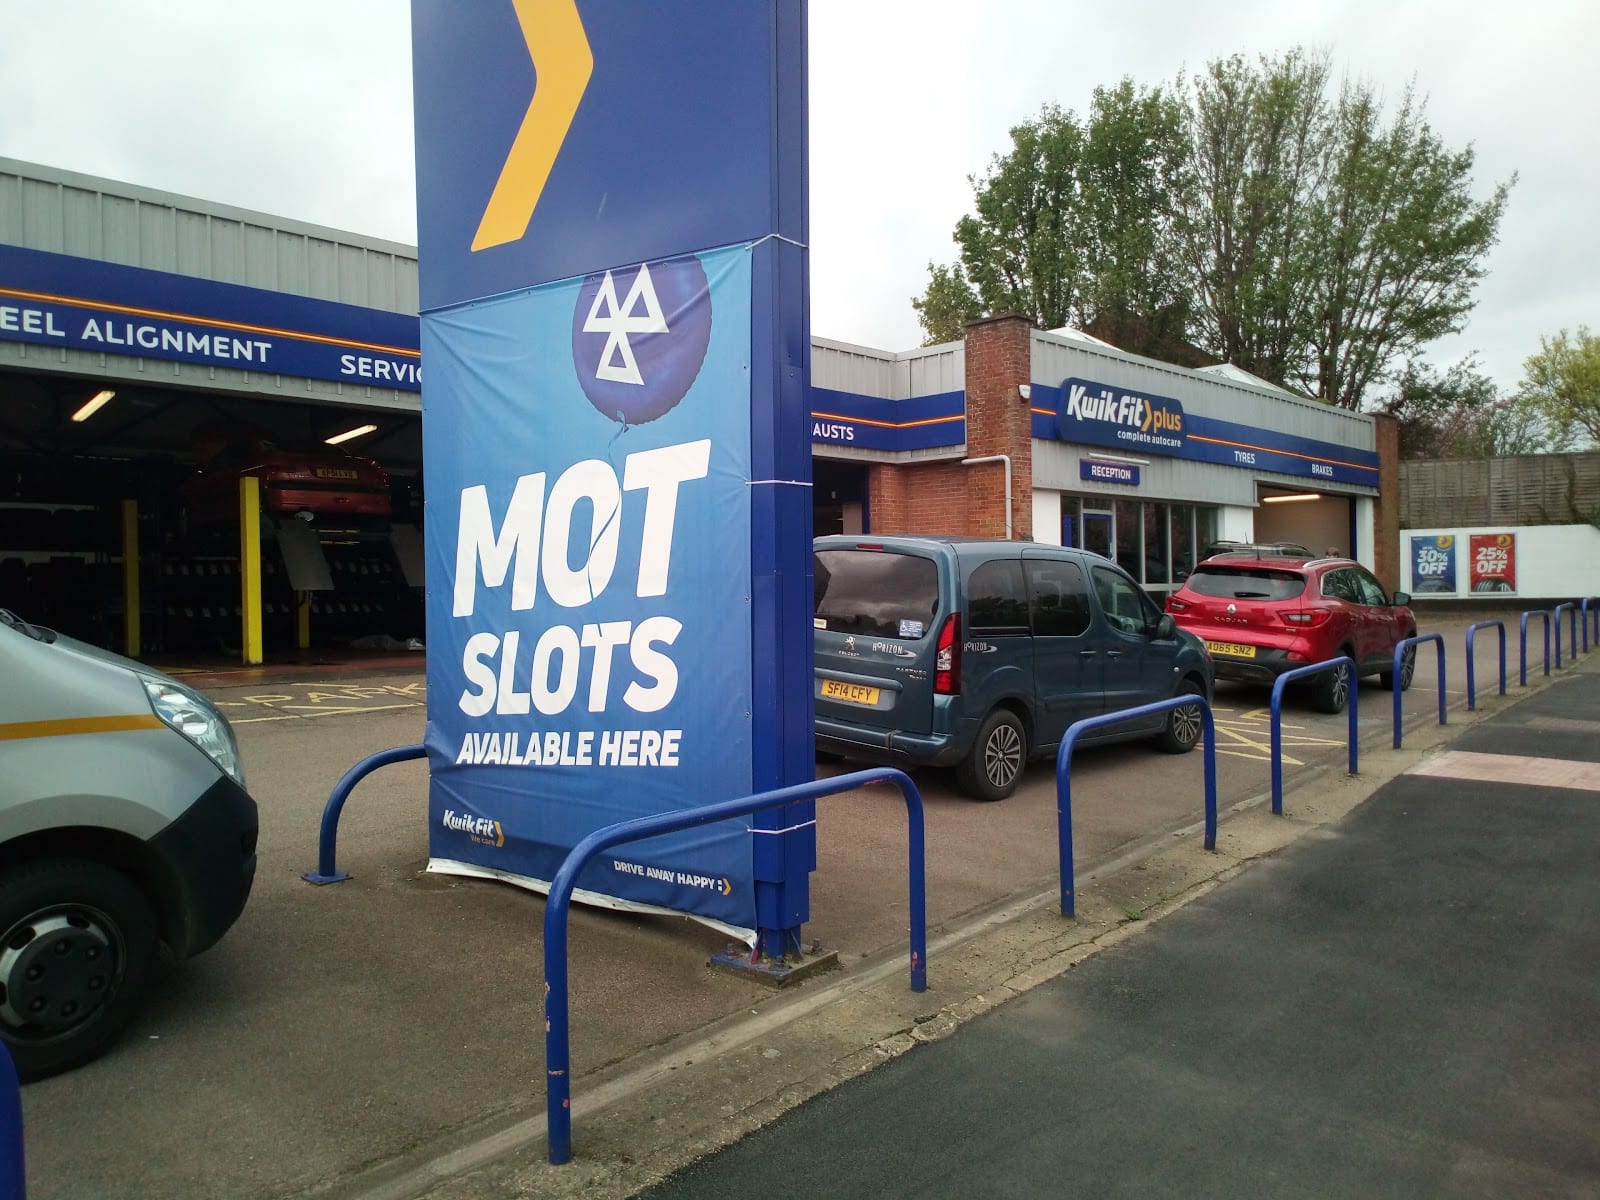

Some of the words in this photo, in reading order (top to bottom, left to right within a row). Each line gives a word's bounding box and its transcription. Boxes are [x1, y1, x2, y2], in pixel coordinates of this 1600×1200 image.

[81, 318, 272, 363] ALIGNMENT
[1153, 407, 1182, 433] plus
[811, 422, 854, 440] AUSTS
[1117, 430, 1151, 443] complete
[1151, 435, 1182, 448] autocare
[1234, 450, 1256, 464] TYRES
[1091, 465, 1132, 480] RECEPTION
[1311, 463, 1333, 476] BRAKES
[453, 439, 711, 617] MOT
[1417, 549, 1449, 562] 30%
[1476, 546, 1508, 560] 25%
[1418, 562, 1448, 575] OFF
[1476, 560, 1508, 574] OFF
[872, 642, 903, 654] HORIZON
[1233, 645, 1252, 656] SNZ
[458, 616, 683, 717] SLOTS
[827, 681, 849, 697] SF14
[851, 686, 872, 701] CFY
[455, 731, 594, 766] AVAILABLE
[599, 730, 682, 766] HERE
[614, 860, 644, 876] DRIVE
[646, 866, 675, 883] AWAY
[677, 872, 715, 889] HAPPY
